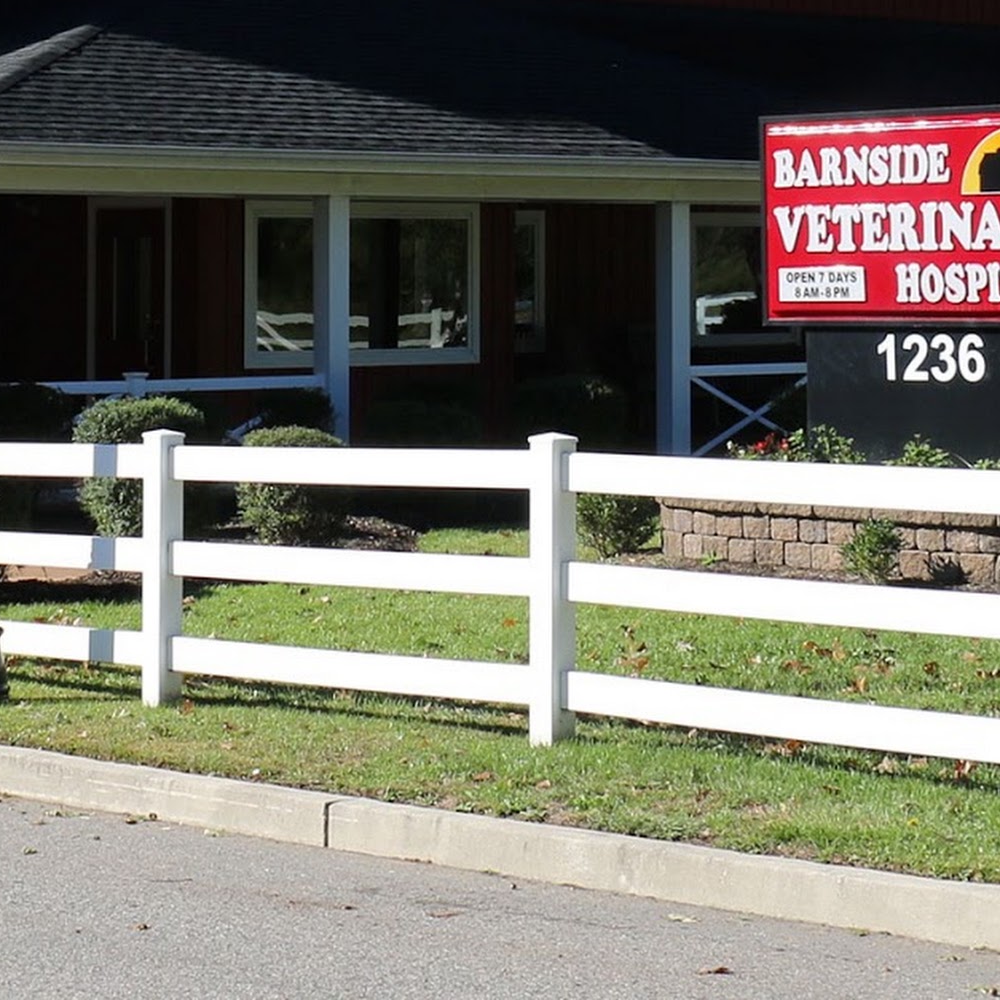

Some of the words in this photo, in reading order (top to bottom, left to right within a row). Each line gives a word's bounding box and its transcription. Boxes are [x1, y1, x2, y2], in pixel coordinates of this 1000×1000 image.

[773, 143, 950, 188] BARNSIDE
[773, 200, 1000, 252] VETERINA
[786, 272, 815, 283] OPEN
[819, 272, 825, 283] 7
[828, 271, 857, 283] DAYS
[895, 261, 1000, 303] HOSPI
[877, 333, 986, 382] 1236
